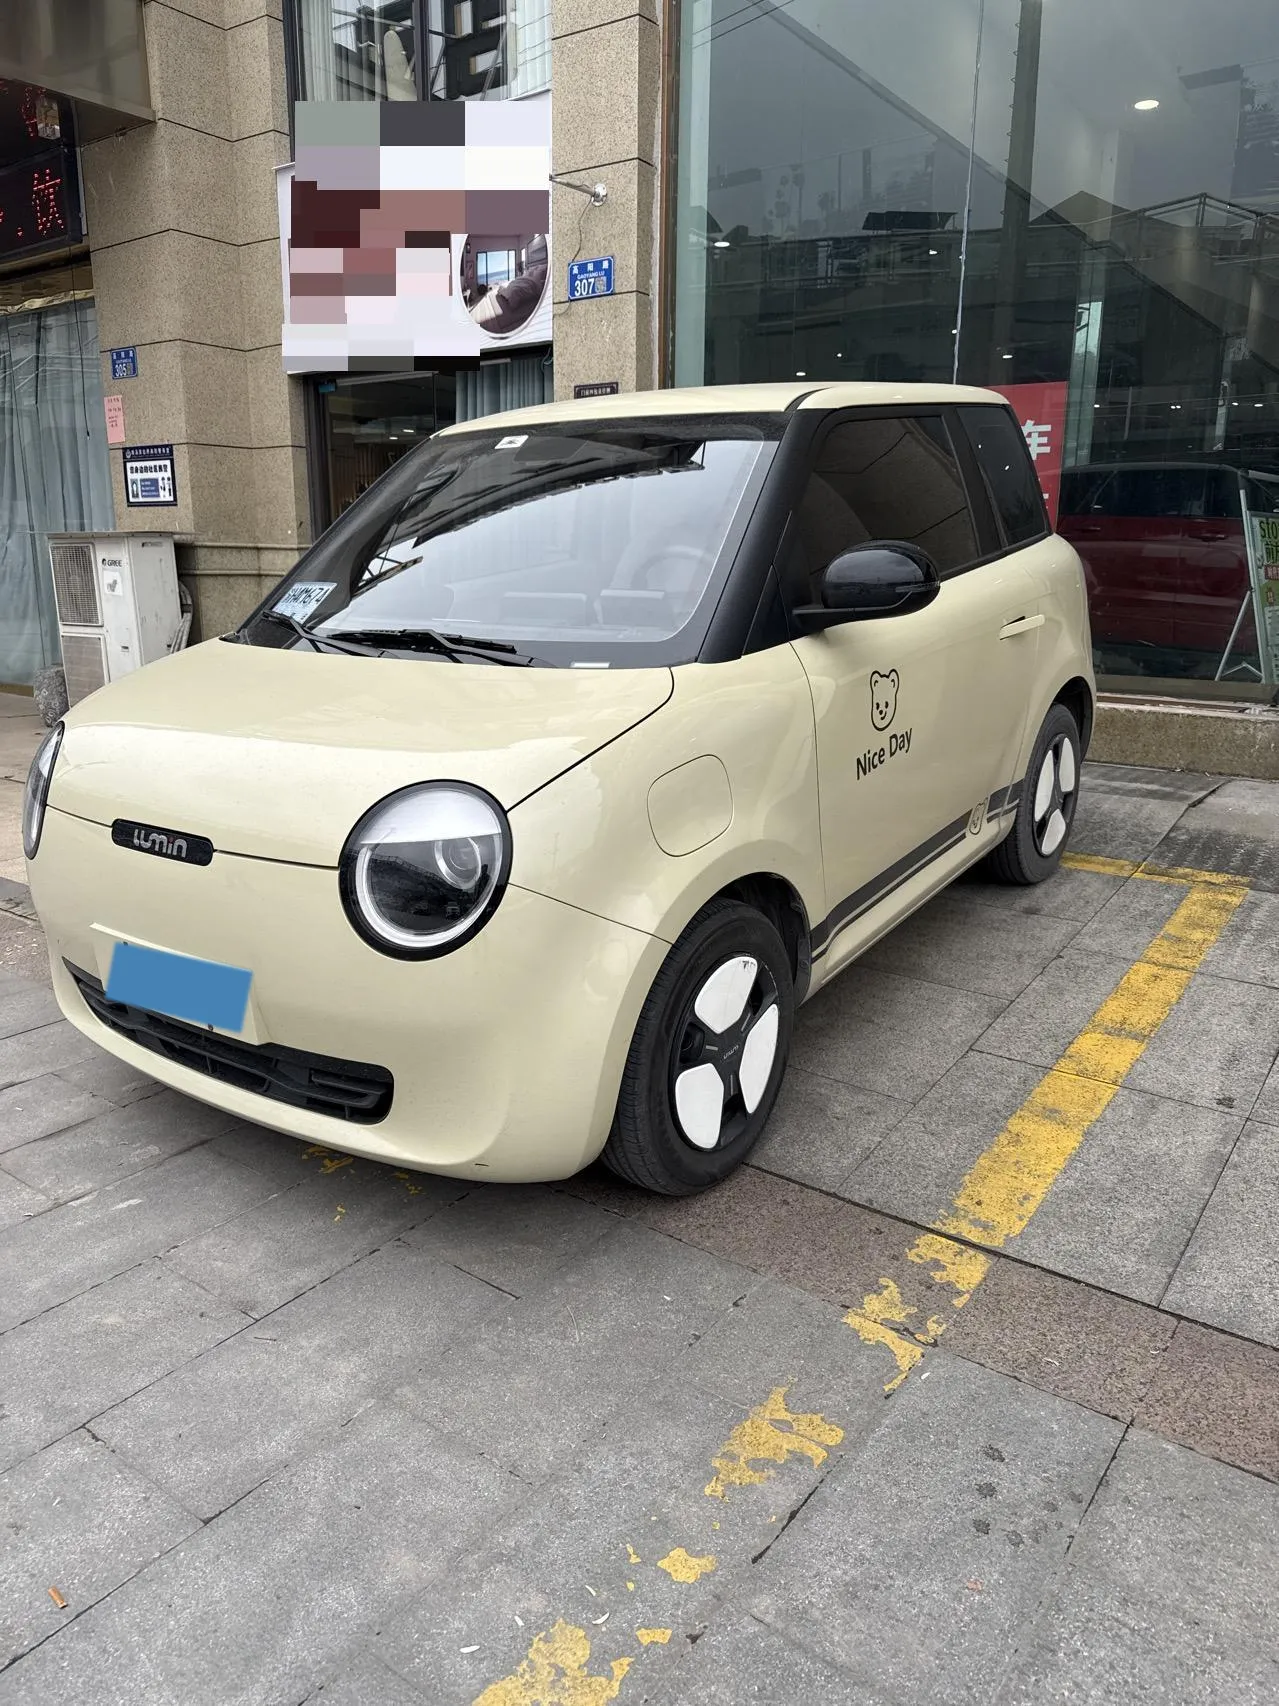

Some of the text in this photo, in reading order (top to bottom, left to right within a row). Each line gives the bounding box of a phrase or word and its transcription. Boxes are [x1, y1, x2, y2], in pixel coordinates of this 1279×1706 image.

[574, 278, 595, 297] 307
[115, 363, 127, 377] 305
[107, 559, 123, 567] GREE
[856, 727, 913, 781] Nice Day
